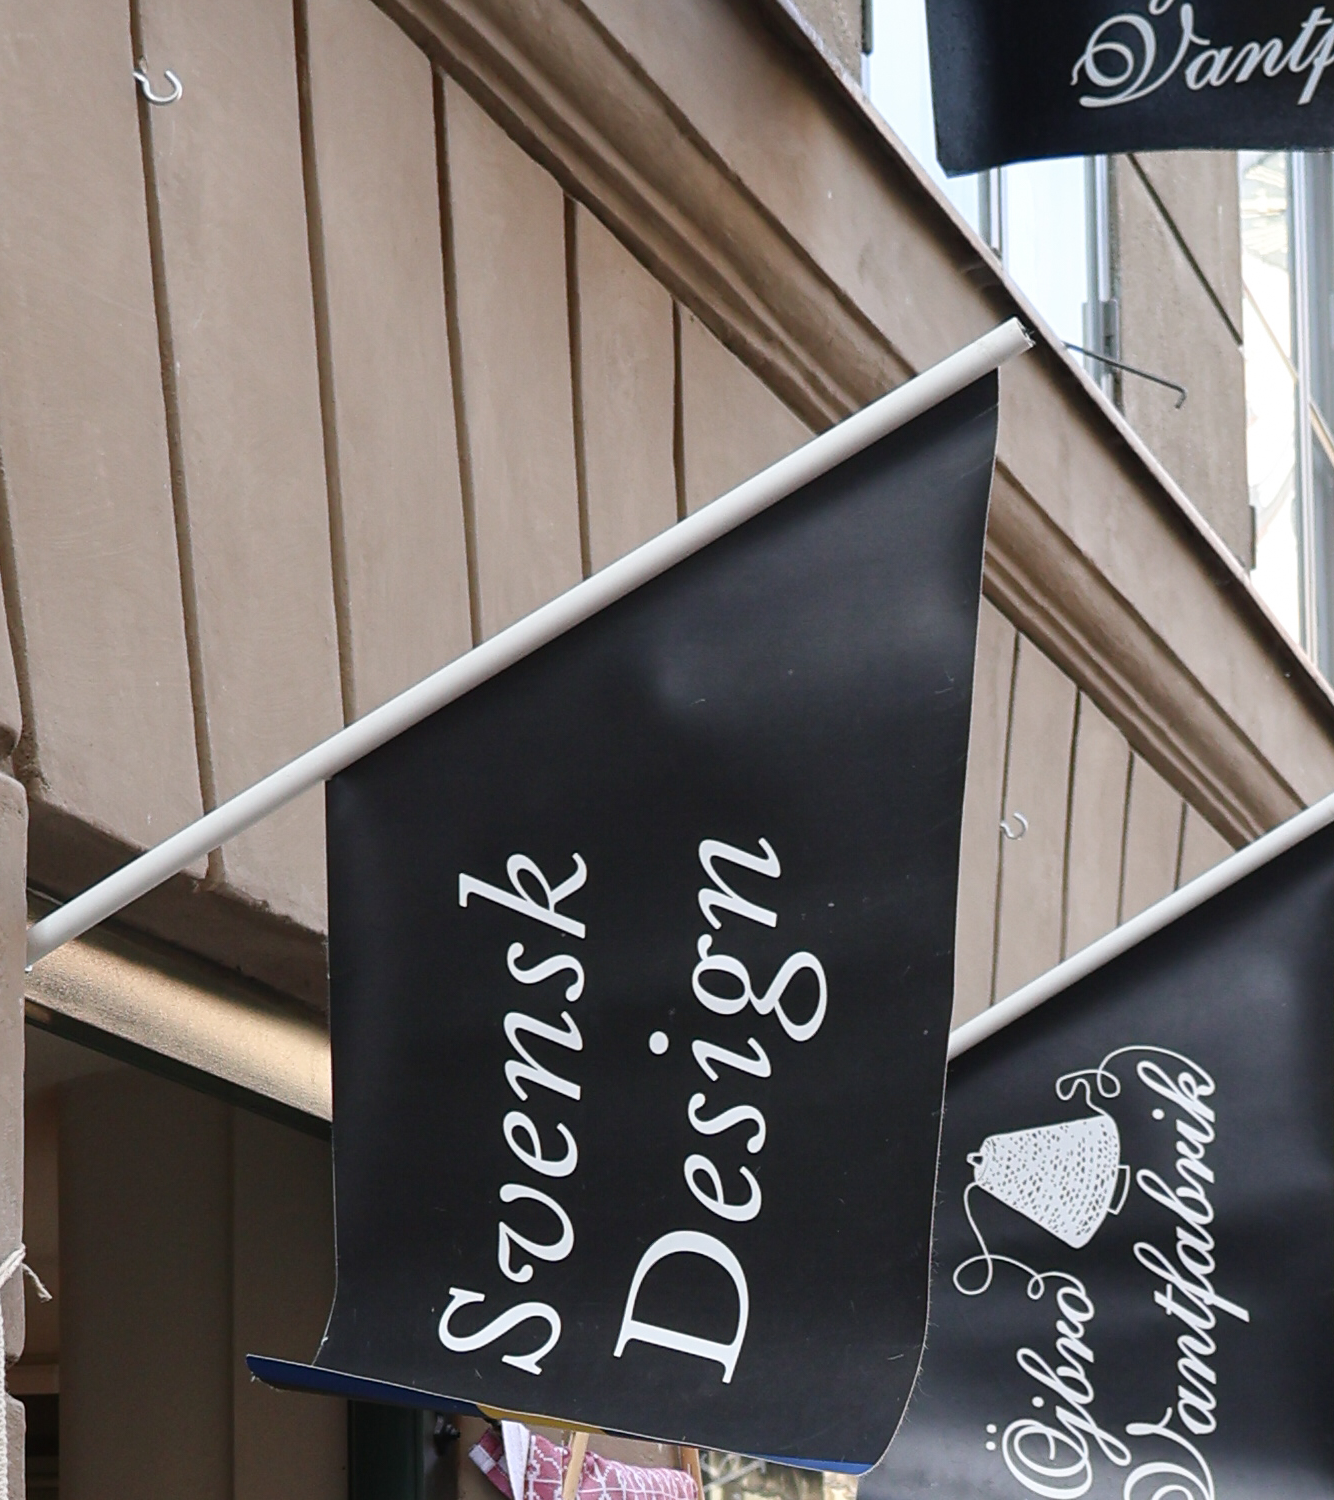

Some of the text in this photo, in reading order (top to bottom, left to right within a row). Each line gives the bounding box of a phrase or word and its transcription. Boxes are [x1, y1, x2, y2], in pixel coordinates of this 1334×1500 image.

[439, 851, 589, 1375] Svensk
[613, 836, 828, 1384] Design
[985, 1272, 1131, 1500] Öjbro
